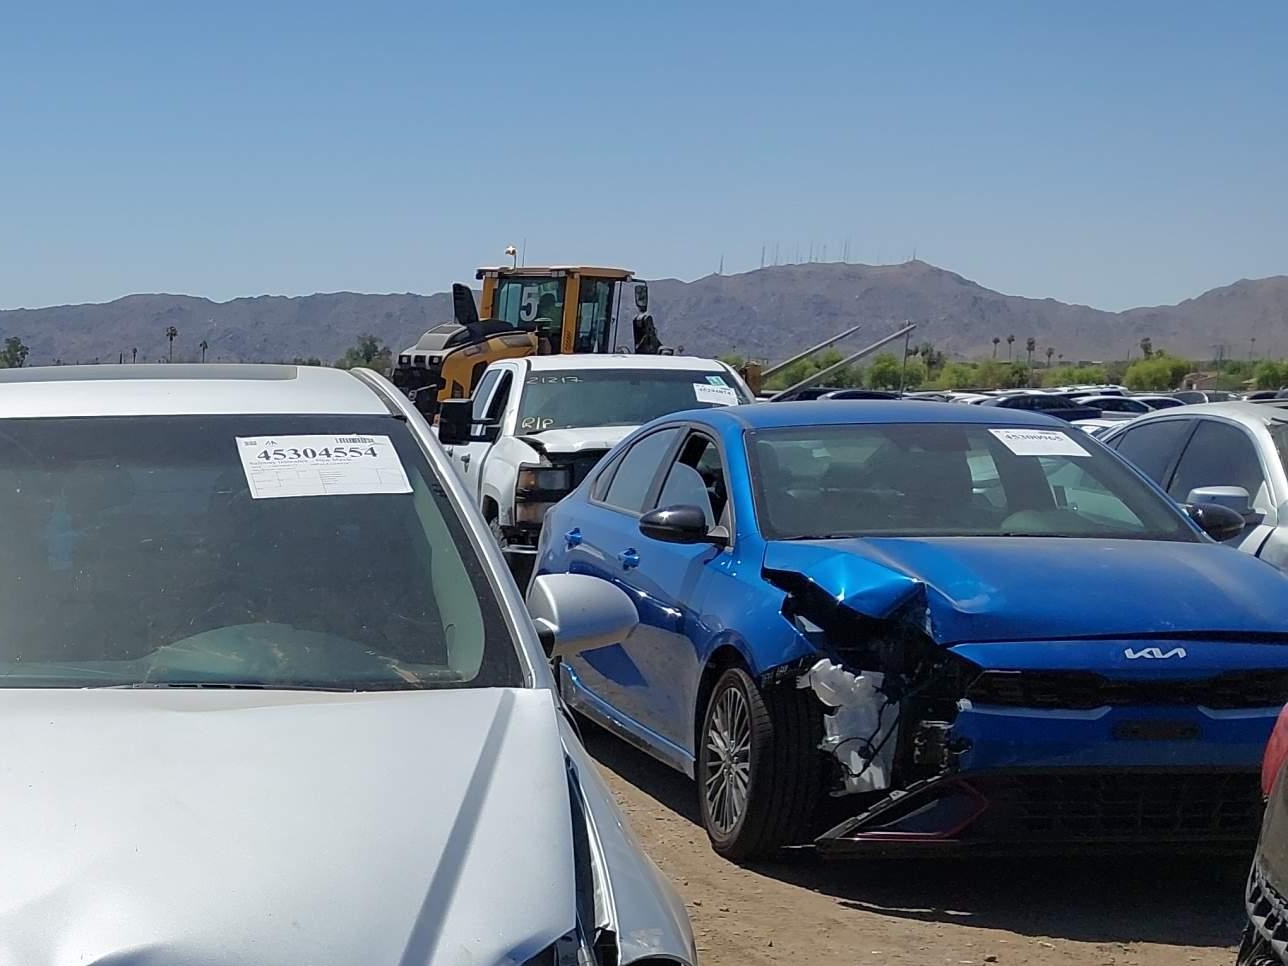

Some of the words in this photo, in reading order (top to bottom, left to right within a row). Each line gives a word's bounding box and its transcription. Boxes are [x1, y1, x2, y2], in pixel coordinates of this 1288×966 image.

[519, 286, 540, 322] 5
[257, 446, 378, 461] 45304554
[1124, 647, 1187, 659] KIA
